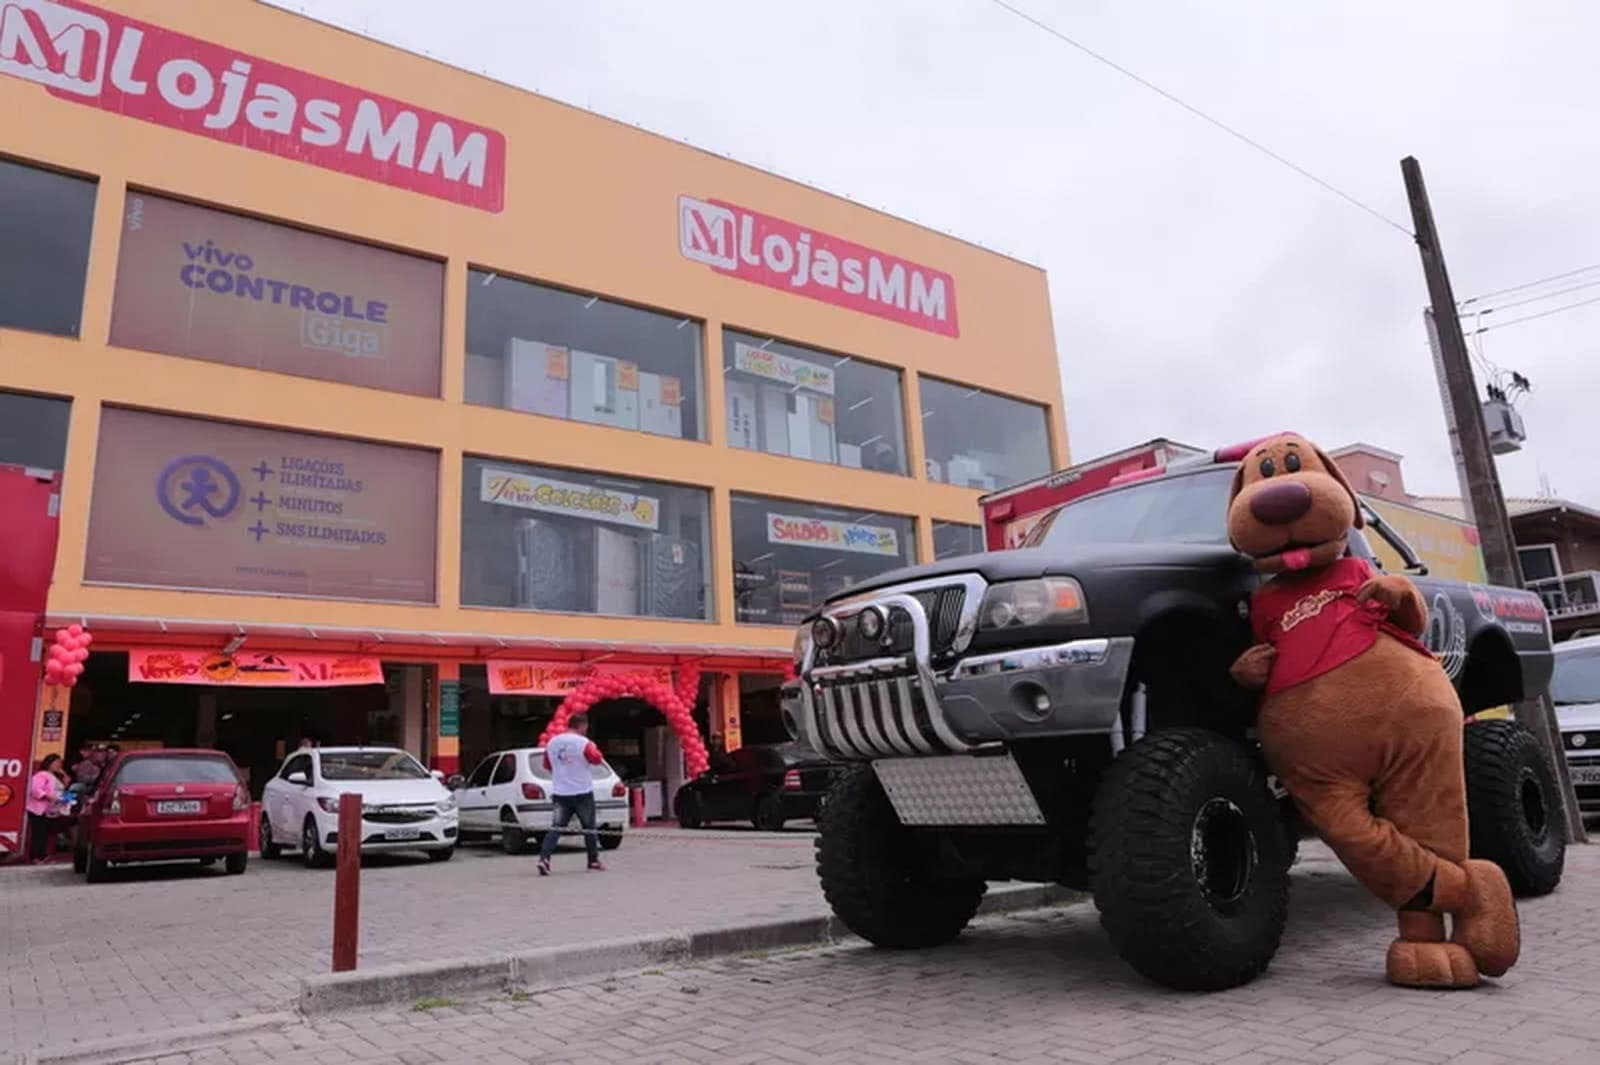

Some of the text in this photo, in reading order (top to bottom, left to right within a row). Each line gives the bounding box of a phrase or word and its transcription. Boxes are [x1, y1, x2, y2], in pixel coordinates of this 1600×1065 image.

[111, 27, 489, 188] LojasMM
[182, 239, 253, 271] vivo
[739, 214, 947, 320] LojasMM
[180, 264, 388, 324] CONTROLE
[307, 317, 381, 354] Giga
[280, 473, 363, 493] ILIMITADAS
[279, 496, 343, 515] MINUTOS
[276, 523, 387, 545] SMS ILIMITADOS
